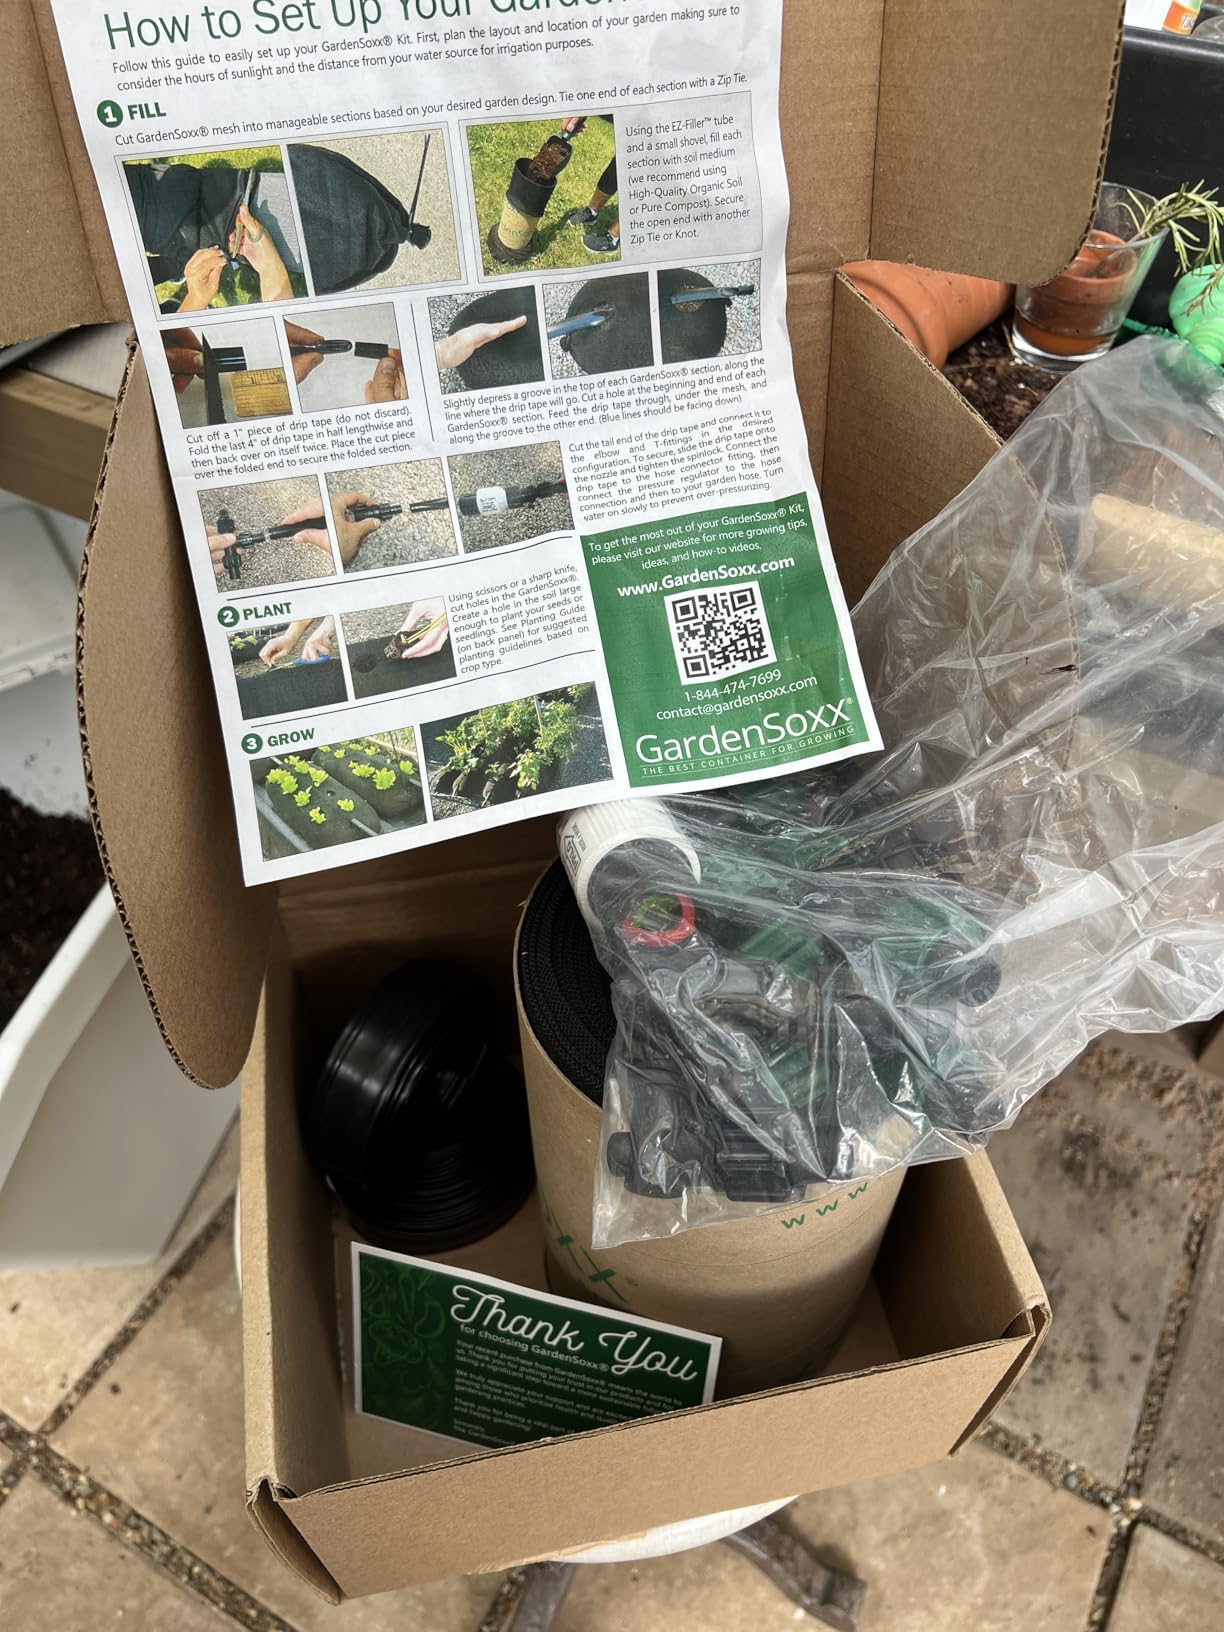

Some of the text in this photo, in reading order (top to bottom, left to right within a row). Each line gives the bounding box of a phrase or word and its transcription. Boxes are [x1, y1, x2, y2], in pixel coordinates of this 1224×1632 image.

[104, 11, 191, 50] How
[201, 5, 242, 40] to
[253, 0, 321, 34] Set
[332, 0, 382, 33] Up
[112, 60, 147, 72] Follow
[151, 56, 171, 69] this
[175, 53, 205, 69] guide
[208, 53, 220, 63] to
[224, 48, 253, 62] easily
[257, 47, 272, 58] set
[276, 47, 290, 58] up
[294, 44, 316, 57] your
[396, 33, 412, 44] Kit.
[416, 31, 439, 43] First,
[443, 29, 465, 43] plan
[468, 26, 485, 38] the
[488, 25, 520, 39] layout
[524, 21, 543, 34] and
[547, 18, 587, 31] location
[591, 15, 602, 27] of
[605, 16, 628, 29] your
[632, 11, 667, 27] garden
[671, 8, 704, 21] making
[708, 7, 726, 17] sure
[730, 5, 739, 15] to
[117, 38, 593, 90] consider the hours of sunlight and the distance from your water source for irrigation purposes.
[114, 134, 134, 145] Cut
[212, 122, 240, 135] mesh
[242, 121, 263, 132] into
[265, 114, 327, 129] manageable
[330, 110, 370, 123] sections
[373, 105, 402, 118] based
[405, 106, 419, 115] on
[421, 104, 443, 117] your
[446, 97, 481, 111] desired
[484, 95, 518, 110] garden
[521, 93, 556, 106] design.
[559, 90, 573, 101] Tie
[576, 91, 595, 100] one
[598, 86, 616, 98] end
[619, 84, 629, 96] of
[632, 83, 654, 95] each
[656, 80, 686, 92] section
[688, 76, 707, 88] with
[709, 78, 714, 86] a
[717, 74, 731, 87] Zip
[733, 72, 747, 82] Tie.
[128, 102, 166, 121] FILL
[625, 125, 652, 137] Using
[655, 122, 669, 133] the
[713, 114, 733, 125] tube
[626, 128, 742, 153] and a small shovel, fill each
[627, 147, 735, 168] section with soil medium
[628, 165, 726, 186] (we recommend using
[628, 176, 742, 200] High-Quality Organic Soil
[443, 396, 475, 410] Slightly
[477, 393, 511, 405] depress
[520, 388, 551, 401] groove
[553, 385, 561, 394] in
[562, 383, 577, 392] the
[579, 382, 594, 391] top
[596, 378, 605, 388] of
[607, 375, 627, 386] each
[724, 360, 748, 370] along
[750, 356, 764, 366] the
[194, 470, 214, 479] over
[216, 467, 232, 476] the
[234, 461, 264, 473] folded
[266, 458, 284, 469] end
[298, 455, 328, 465] secure
[329, 451, 345, 460] the
[347, 446, 376, 458] folded
[589, 542, 601, 551] To
[603, 538, 619, 552] get
[621, 535, 637, 545] the
[639, 529, 664, 541] most
[666, 525, 682, 535] out
[684, 521, 694, 531] of
[696, 519, 718, 532] your
[789, 503, 805, 514] Kit,
[591, 518, 807, 565] please visit our website for more growing tips,
[641, 542, 761, 569] ideas, and how-to videos.
[618, 556, 795, 597] www.GardenSoxx.com
[243, 602, 292, 621] PLANT
[501, 623, 517, 632] See
[520, 613, 555, 626] Planting
[559, 604, 584, 616] Guide
[656, 676, 818, 720] contact@gardensoxx.com
[685, 668, 782, 702] 1-844-474-7699
[268, 728, 315, 747] GROW
[643, 725, 853, 774] THE BEST CONTAINER FOR GROWING
[451, 1285, 584, 1350] Thank
[599, 1331, 698, 1381] You
